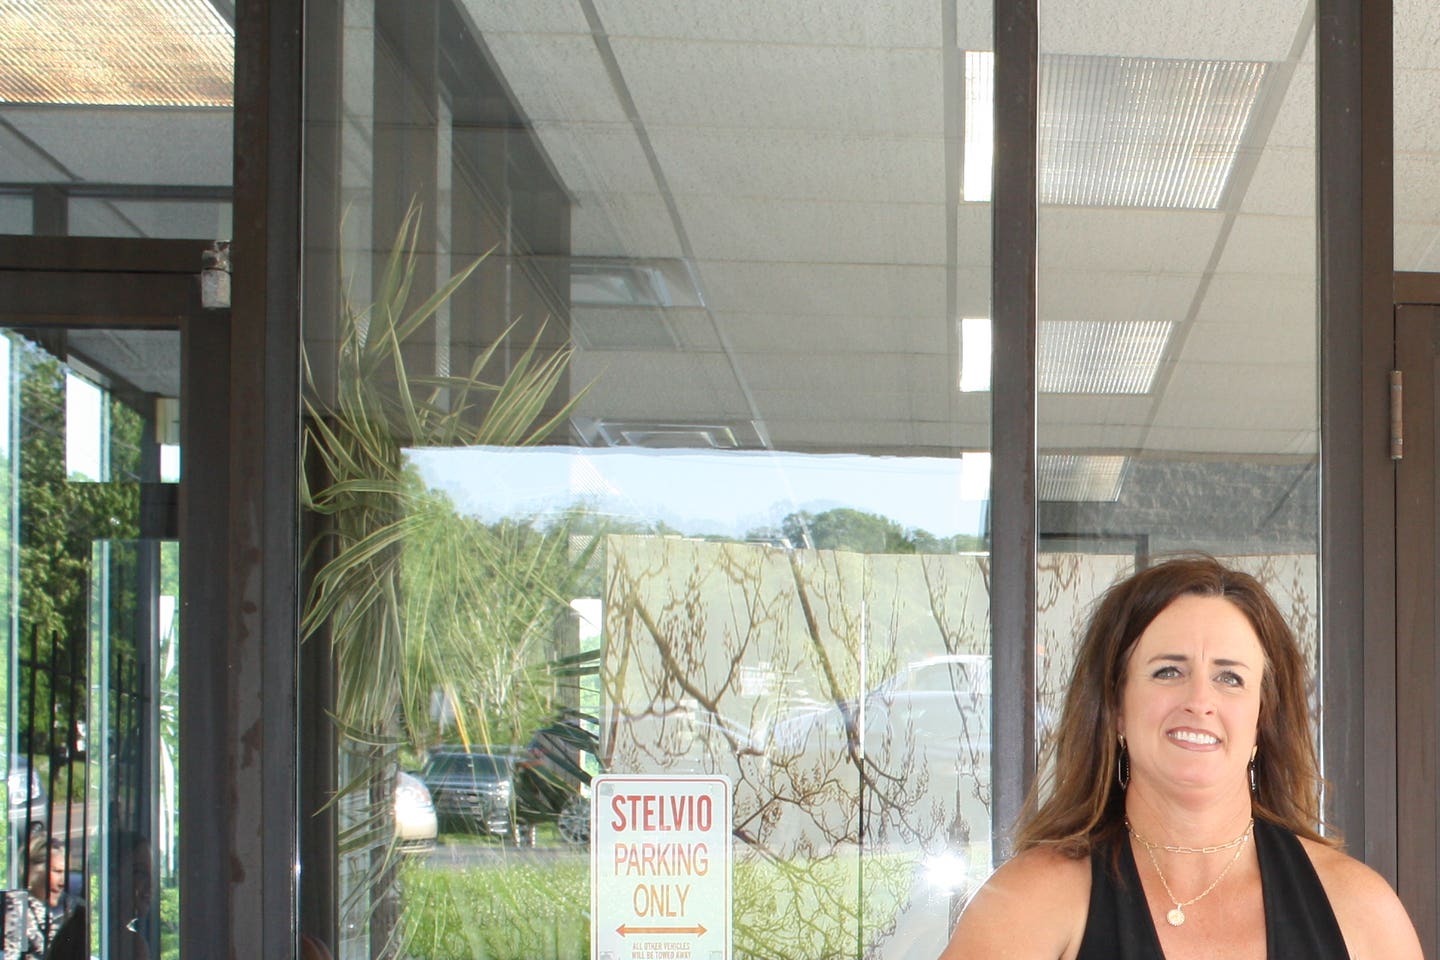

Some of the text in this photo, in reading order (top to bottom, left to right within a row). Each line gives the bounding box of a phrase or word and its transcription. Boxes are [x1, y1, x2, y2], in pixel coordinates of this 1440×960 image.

[611, 794, 712, 832] STELVIO
[614, 843, 709, 876] PARKING
[633, 883, 690, 917] ONLY
[631, 951, 692, 960] WILL BE TOWED AWAY
[632, 942, 691, 951] ALL OTHER VEHICLES
